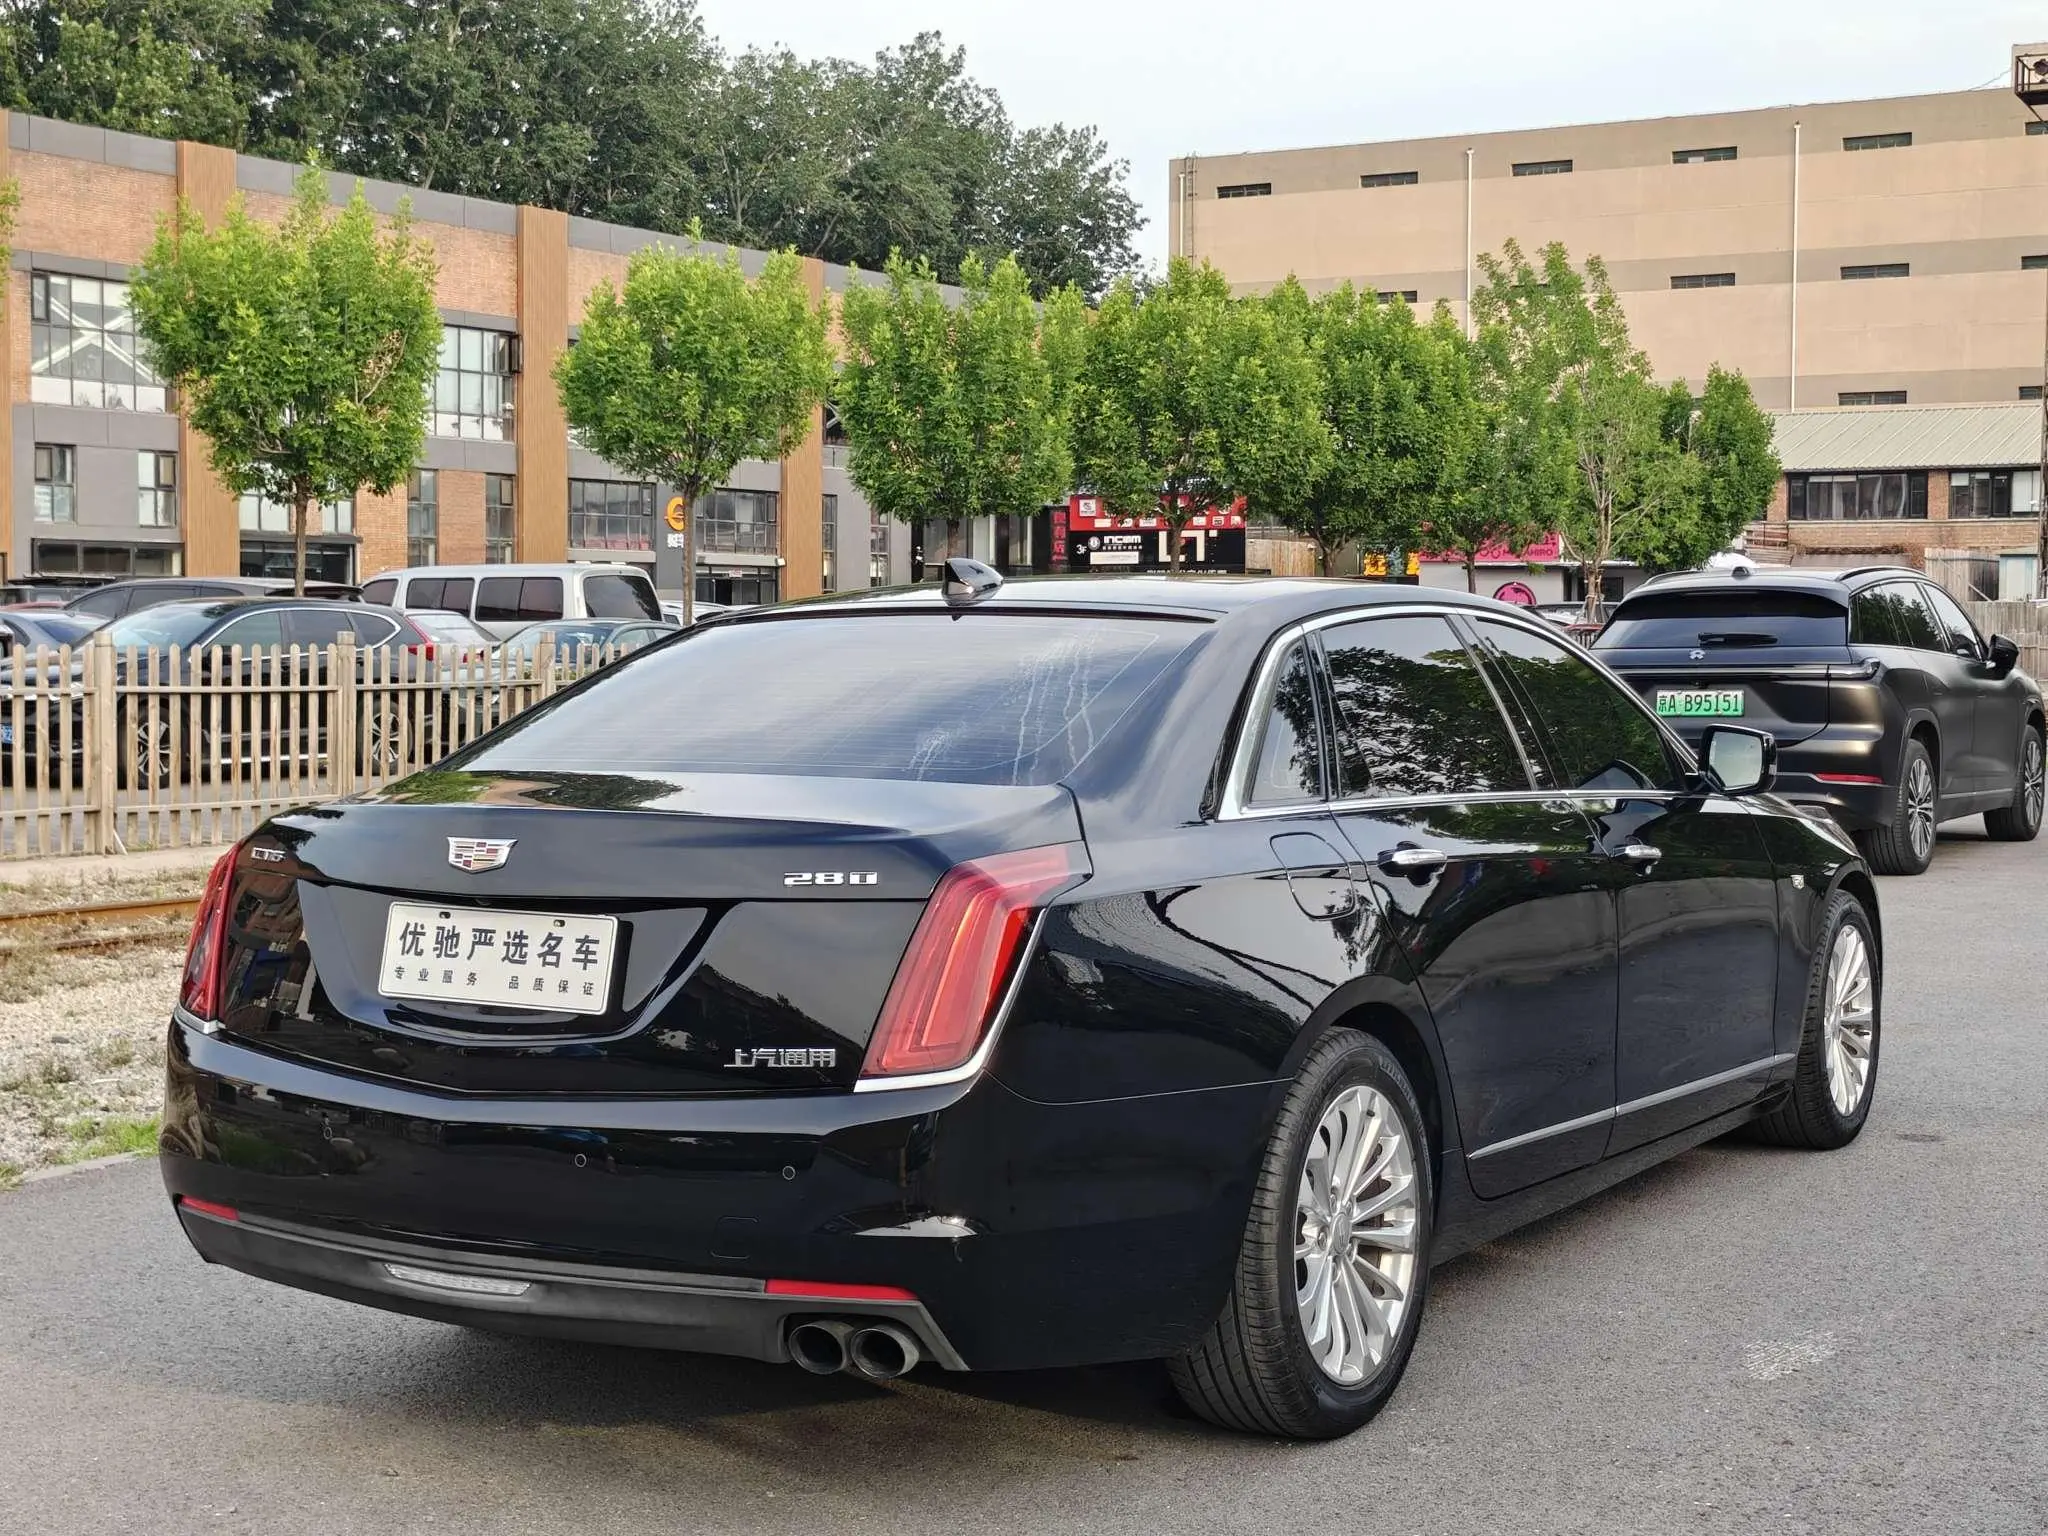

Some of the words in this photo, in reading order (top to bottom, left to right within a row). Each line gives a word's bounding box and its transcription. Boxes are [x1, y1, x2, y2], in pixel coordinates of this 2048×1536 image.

[1684, 694, 1739, 712] B95151
[783, 871, 878, 886] 28T
[399, 921, 601, 971] 优驰严选名车
[394, 966, 480, 987] 专业服务
[508, 975, 595, 997] 品质保证
[723, 1048, 836, 1068] 上汽通用
